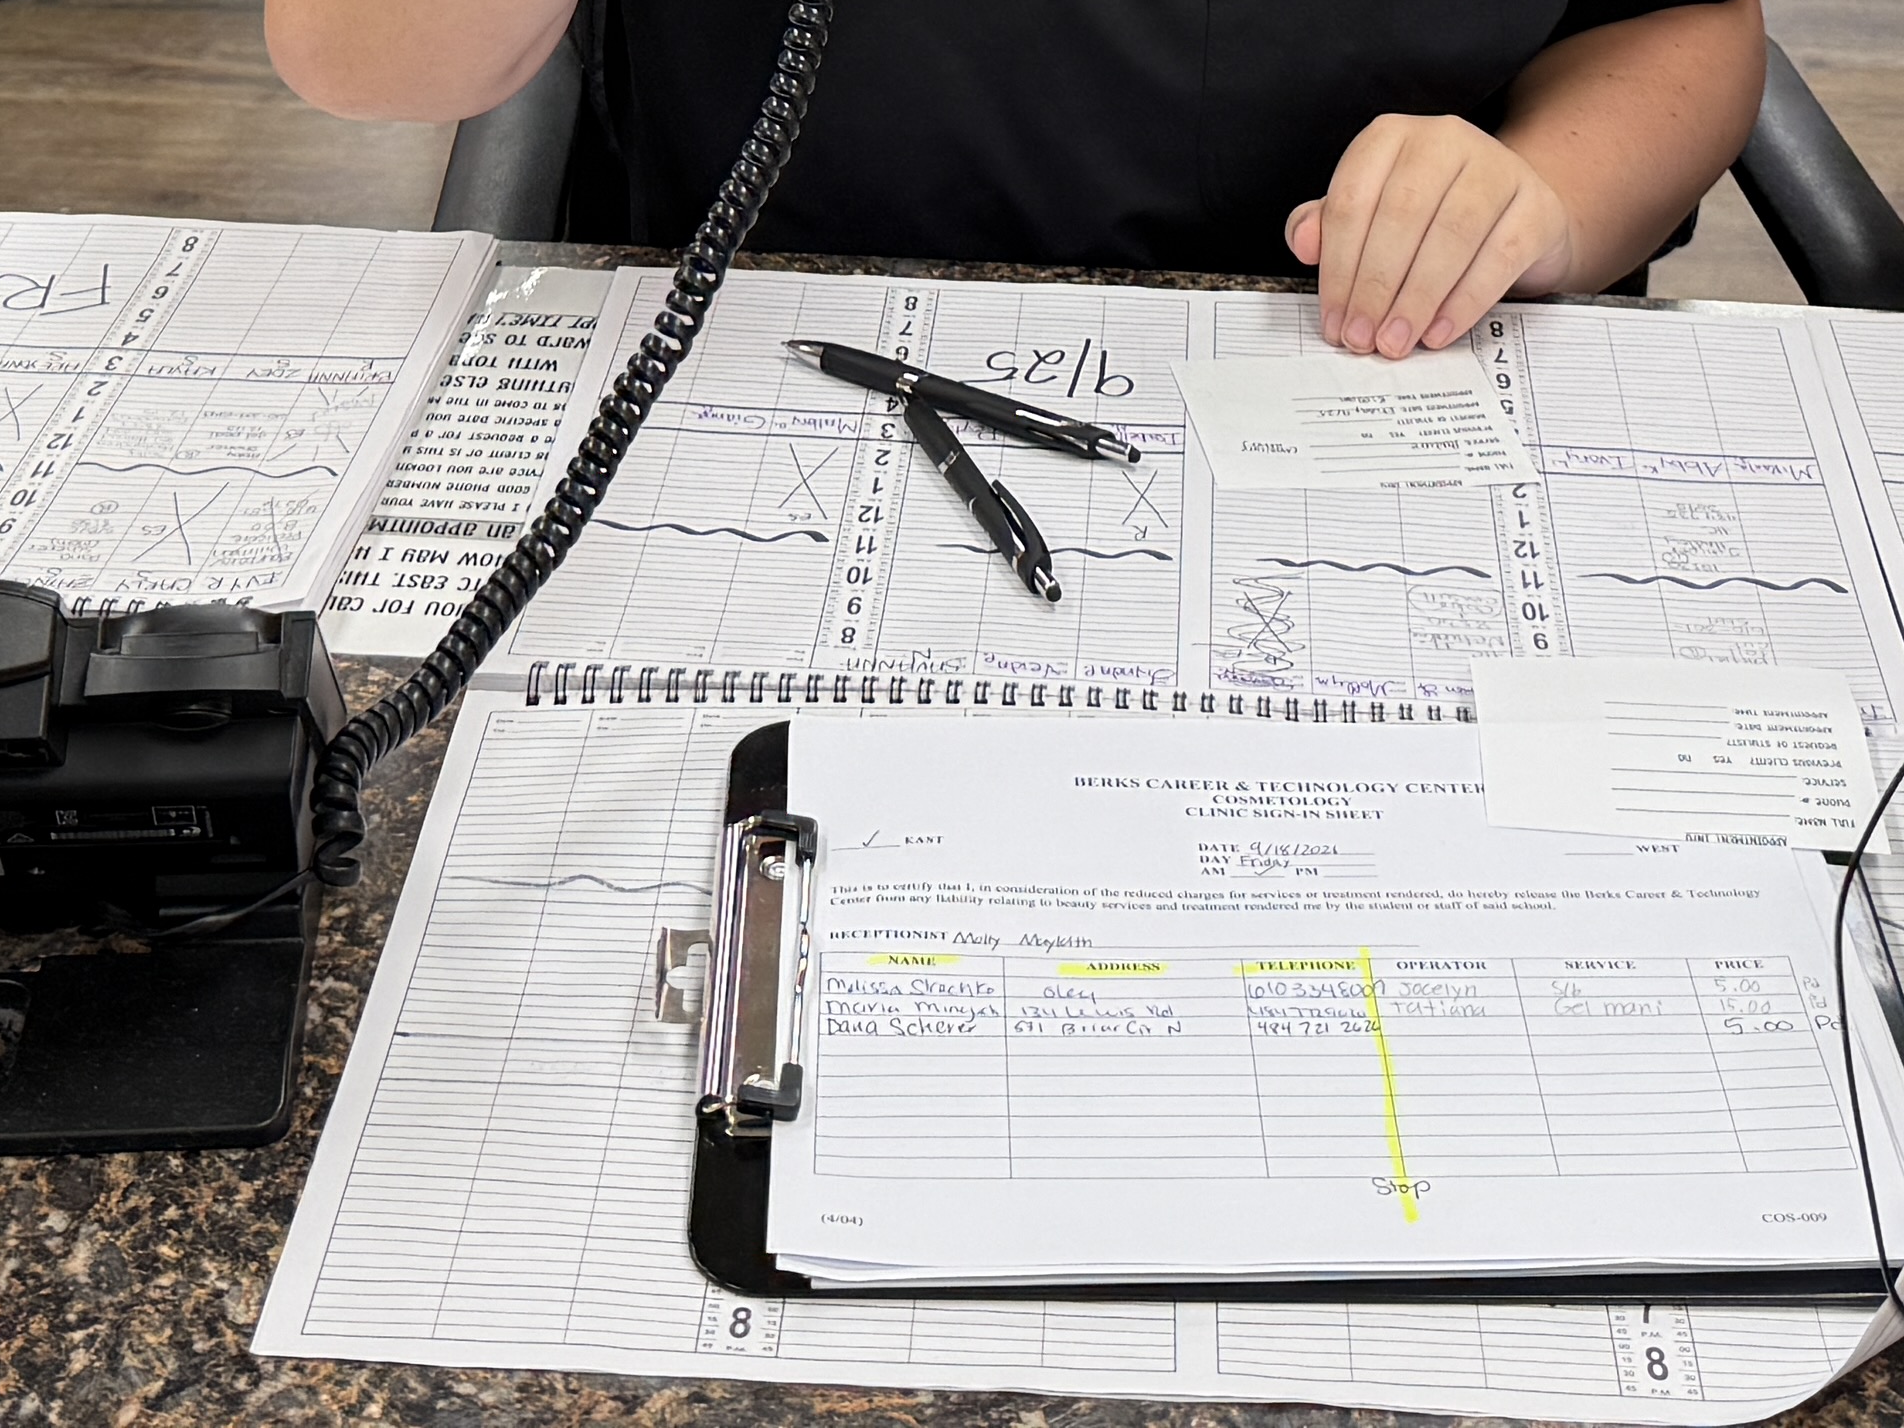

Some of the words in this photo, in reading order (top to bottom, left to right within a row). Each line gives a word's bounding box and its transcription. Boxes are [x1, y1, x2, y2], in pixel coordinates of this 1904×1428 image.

[958, 338, 1136, 399] 9/25
[858, 505, 884, 524] 12
[855, 535, 878, 554] 11
[846, 566, 873, 585] 10
[847, 596, 862, 615] 9
[841, 627, 856, 645] 8
[1075, 776, 1141, 790] BERKS
[1145, 777, 1231, 792] CAREER
[1234, 780, 1252, 792] &
[1256, 780, 1400, 794] TECHNOLOGY
[1212, 795, 1353, 807] COSMETOLOGY
[1185, 806, 1249, 819] CLINIC
[1252, 808, 1321, 819] SIGN-IN
[1325, 809, 1385, 821] SHEET
[904, 834, 945, 846] EAST
[1198, 843, 1240, 853] DATE
[1635, 843, 1681, 854] WEST
[1199, 855, 1232, 865] DAY
[1240, 854, 1291, 871] Friday
[1201, 867, 1227, 877] AM
[1295, 867, 1320, 877] PM
[829, 930, 950, 941] RECEPTIONIST
[887, 954, 938, 965] NAME
[1254, 960, 1357, 971] TELEPHONE
[1395, 960, 1488, 971] OPERATOR
[1564, 959, 1637, 970] SERVICE
[1714, 959, 1765, 970] PRICE
[1085, 961, 1161, 972] ADDRESS
[1723, 1016, 1795, 1035] 5.00
[1371, 1177, 1432, 1200] Stop
[1761, 1212, 1828, 1224] COS-009
[1645, 1346, 1669, 1381] 8
